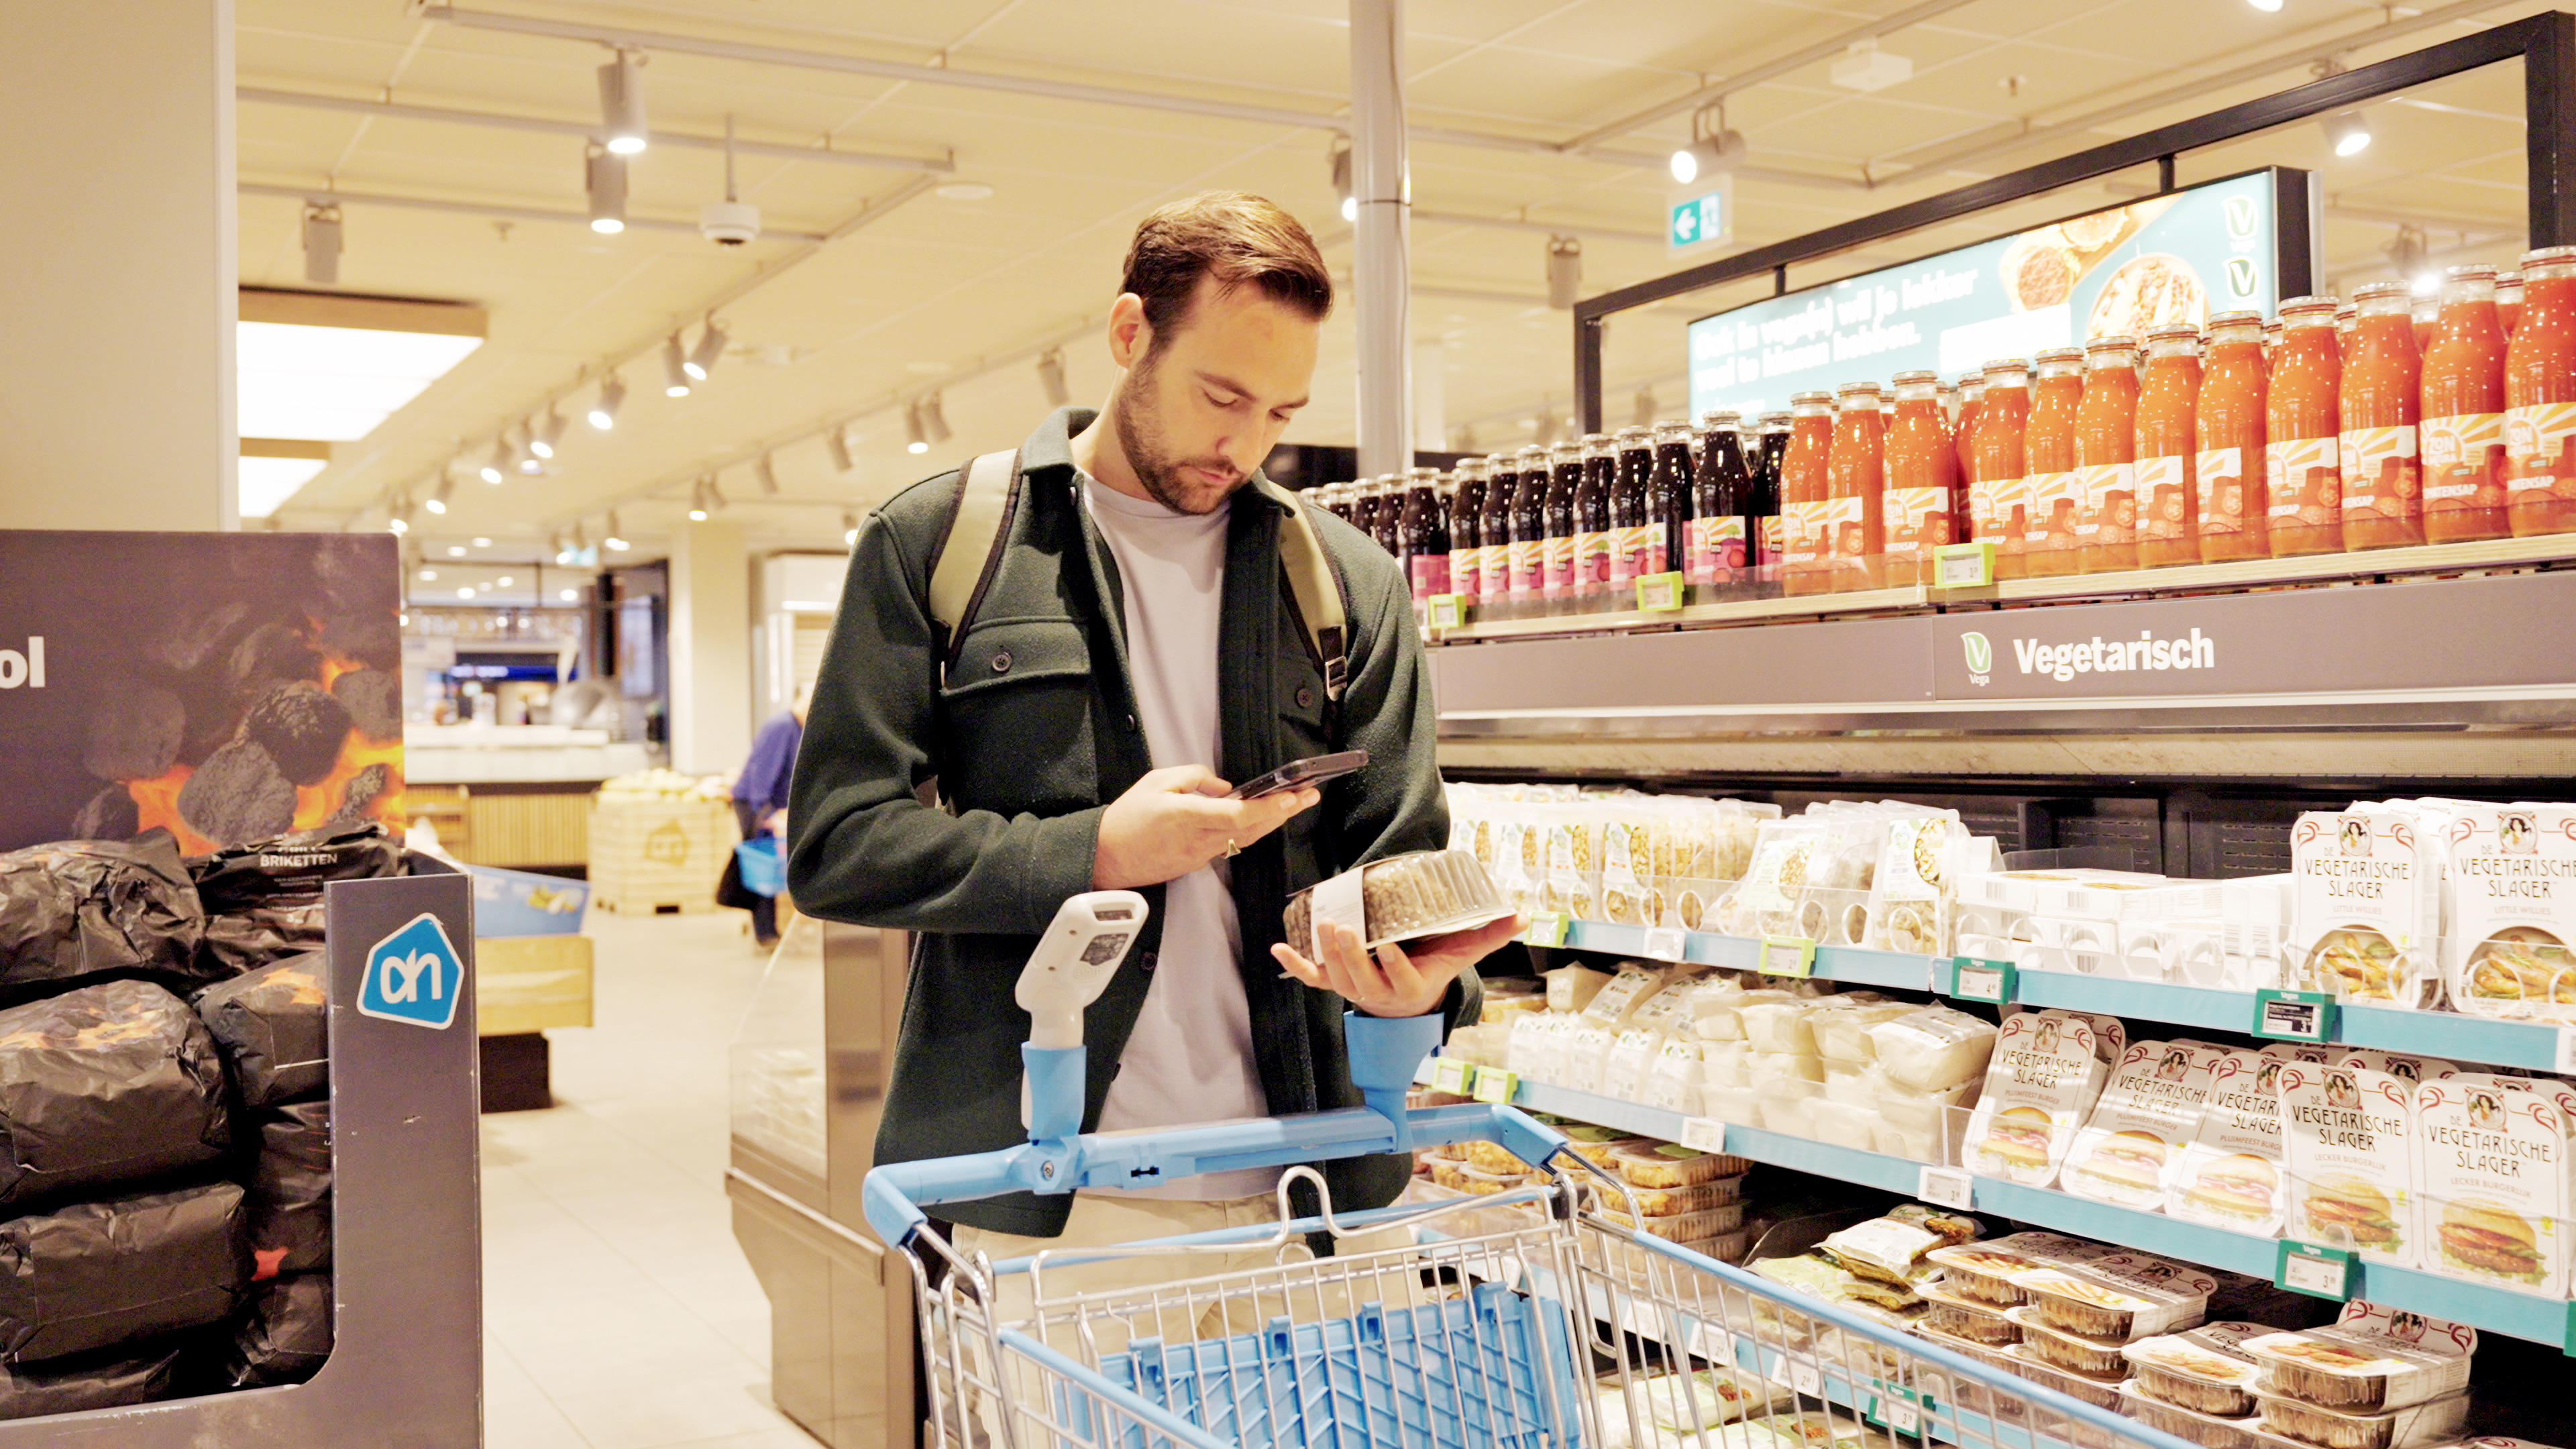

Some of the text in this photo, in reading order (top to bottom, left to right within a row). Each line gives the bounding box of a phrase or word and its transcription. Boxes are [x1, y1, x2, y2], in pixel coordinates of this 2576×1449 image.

[1695, 326, 1735, 360] Ook
[1760, 297, 1834, 345] vega(n)
[1837, 288, 1872, 325] wil
[1874, 285, 1898, 324] je
[1902, 268, 1978, 311] lekker
[1695, 321, 1921, 392] veel te kiezen hebben.
[2508, 427, 2532, 442] ZON
[2428, 436, 2455, 453] ZON
[1972, 496, 1990, 508] ZON
[1886, 504, 1902, 517] ZON
[1784, 517, 1801, 531] ZON
[2013, 627, 2214, 682] Vegetarisch
[1969, 674, 1990, 686] Vega
[2324, 846, 2334, 857] DE
[2481, 845, 2493, 855] DE
[260, 853, 337, 867] BRIKETTEN
[2305, 859, 2409, 879] VEGETARISCHE
[2328, 880, 2383, 899] SLAGER
[2488, 880, 2552, 898] SLAGER
[2333, 905, 2382, 915] LITTLE WILLIES
[2520, 907, 2551, 915] WILLIES
[1970, 959, 1985, 967] Vegan
[2280, 991, 2299, 1000] Vegan
[2020, 1041, 2029, 1050] DE
[2002, 1049, 2082, 1075] VEGETARISCHE
[2014, 1069, 2058, 1089] SLAGER
[2141, 1068, 2151, 1077] DE
[2118, 1075, 2208, 1104] VEGETARISCHE
[2239, 1083, 2249, 1093] DE
[2128, 1094, 2179, 1116] SLAGER
[2310, 1095, 2322, 1106] DE
[2292, 1105, 2403, 1136] VEGETARISCHE
[2450, 1115, 2462, 1126] DE
[2319, 1128, 2376, 1152] SLAGER
[2428, 1125, 2552, 1163] VEGETARISCHE
[2314, 1153, 2342, 1162] LECKER
[2457, 1150, 2520, 1178] SLAGER
[2451, 1177, 2480, 1187] LECKER
[2303, 1245, 2322, 1256] Vegan
[1890, 1385, 1904, 1396] Vegan
